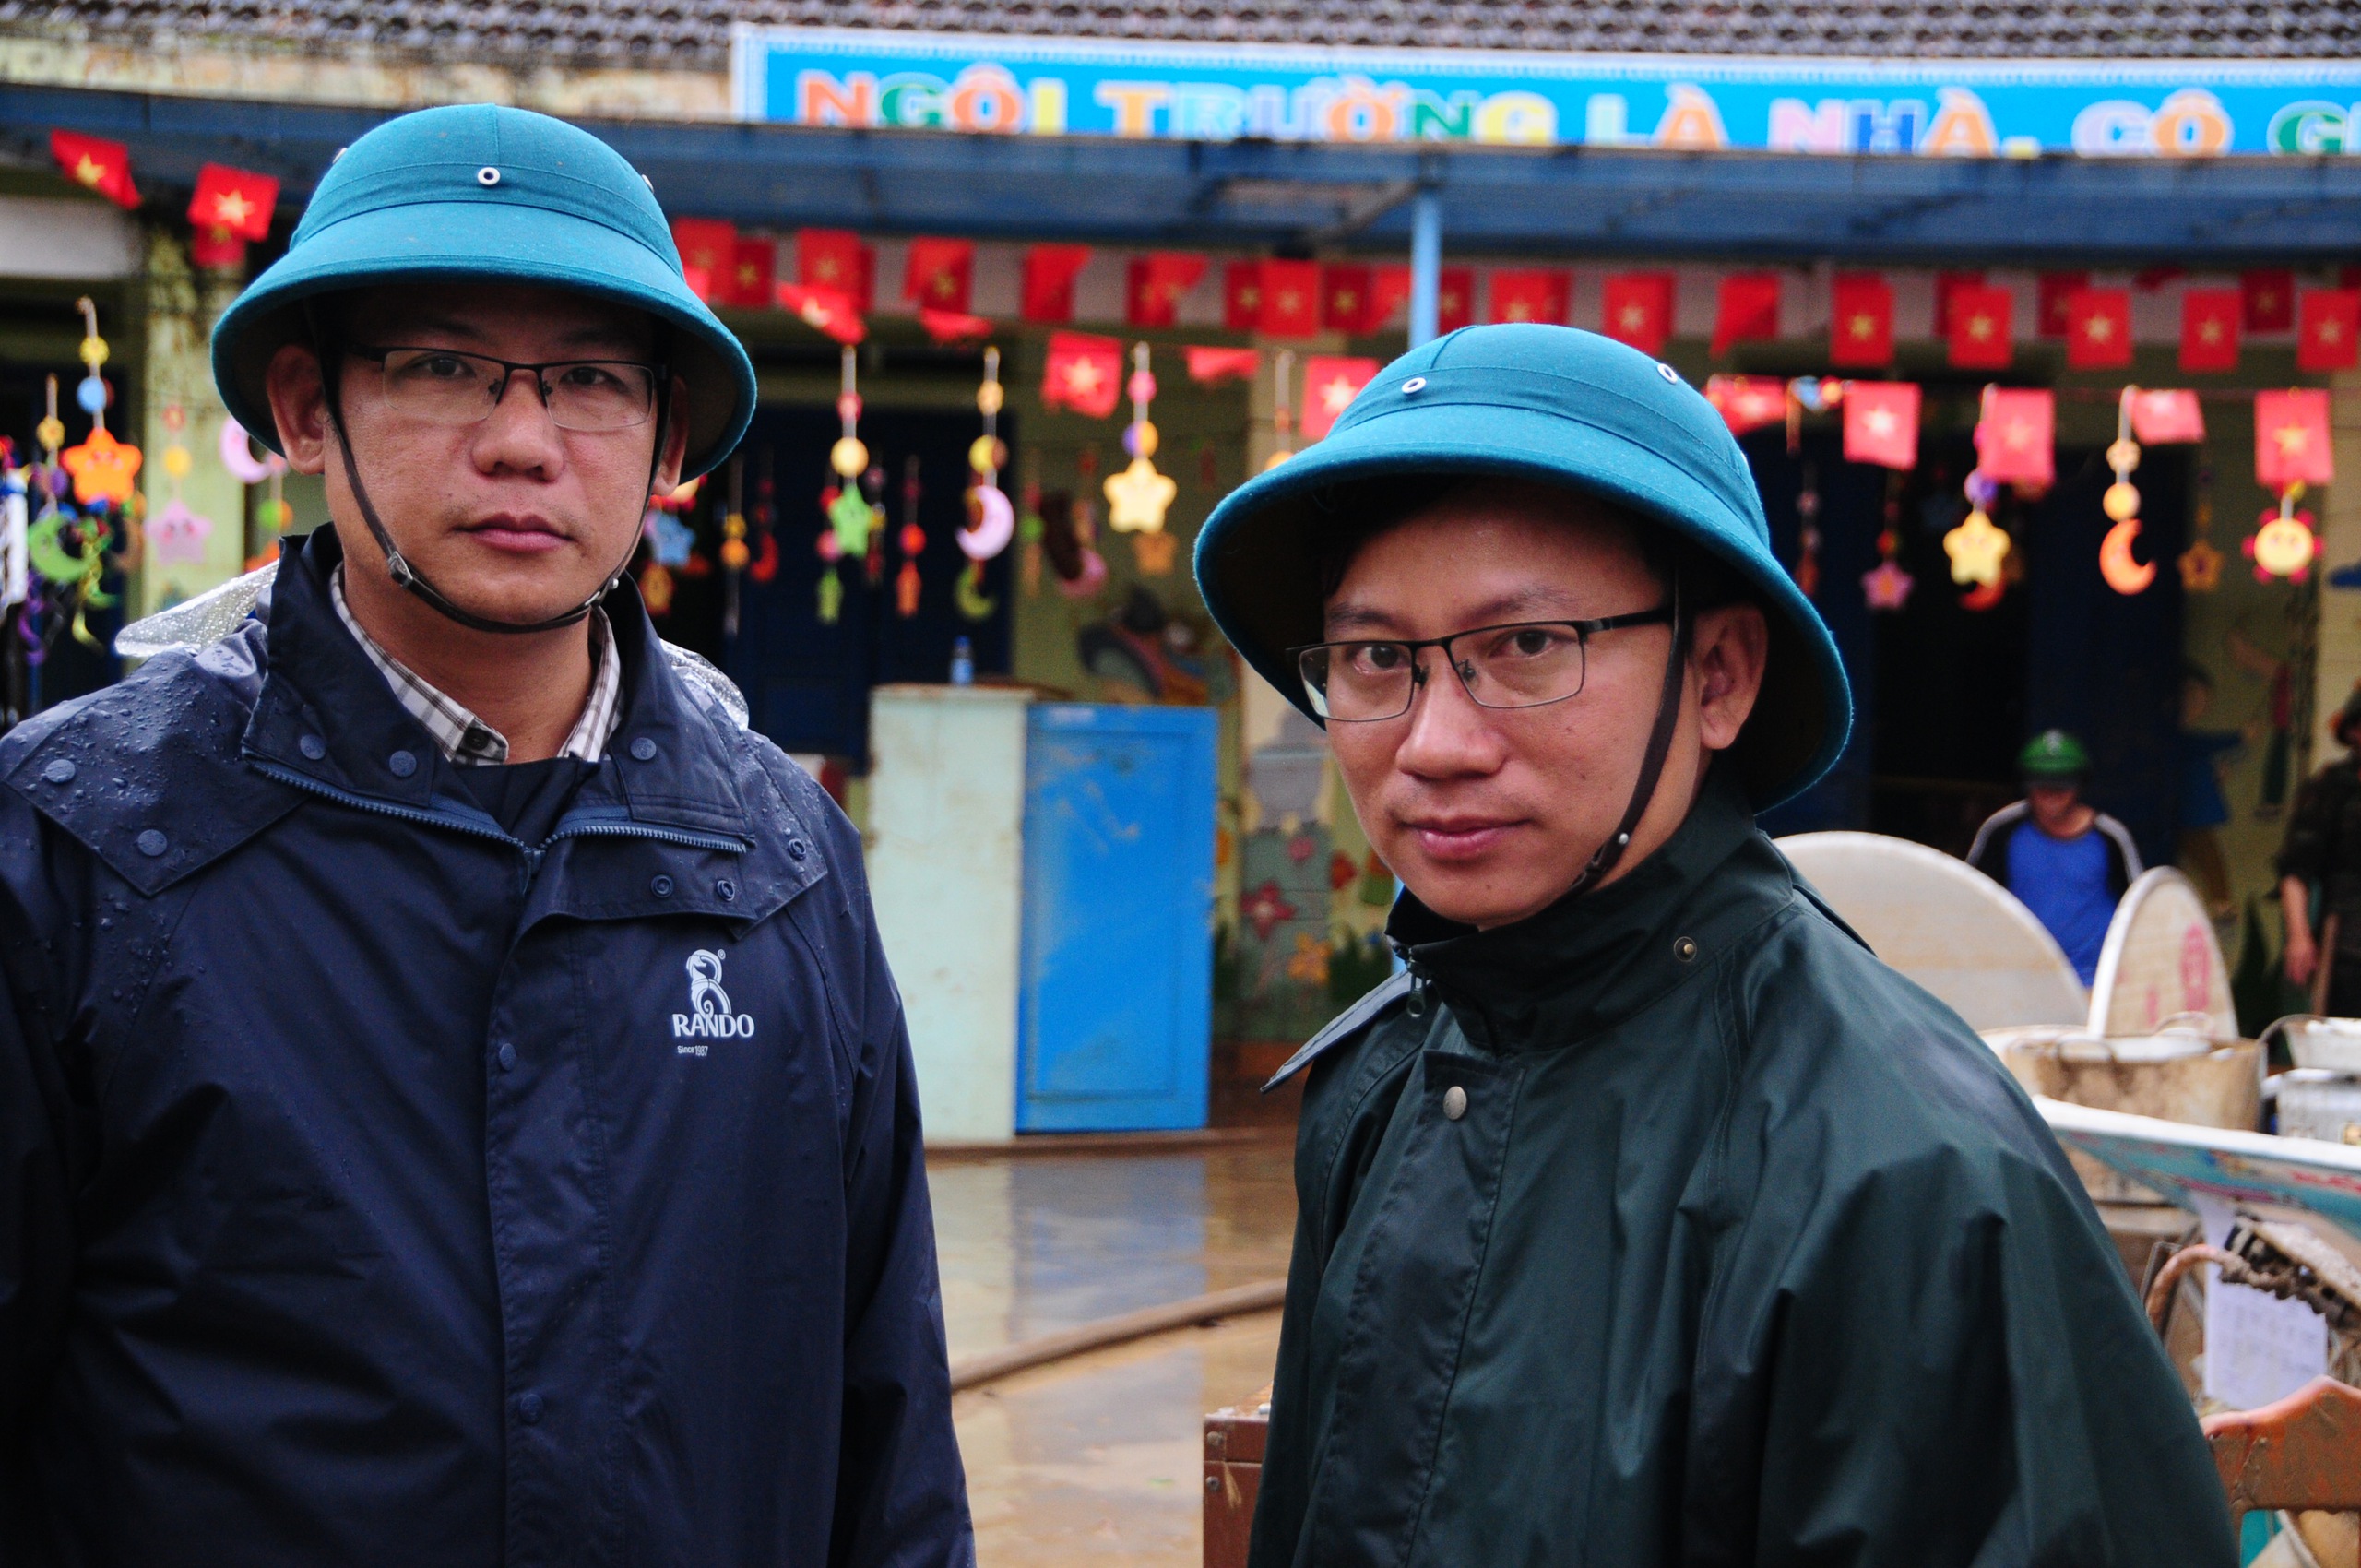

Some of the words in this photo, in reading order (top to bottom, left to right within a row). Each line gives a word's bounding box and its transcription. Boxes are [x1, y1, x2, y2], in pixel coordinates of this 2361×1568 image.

[796, 62, 1067, 136] NGÔI
[1584, 82, 1729, 151] LÀ
[2070, 88, 2235, 159] CÔ
[672, 1013, 755, 1038] RANDO
[677, 1045, 694, 1054] Since
[694, 1045, 709, 1057] 1987
